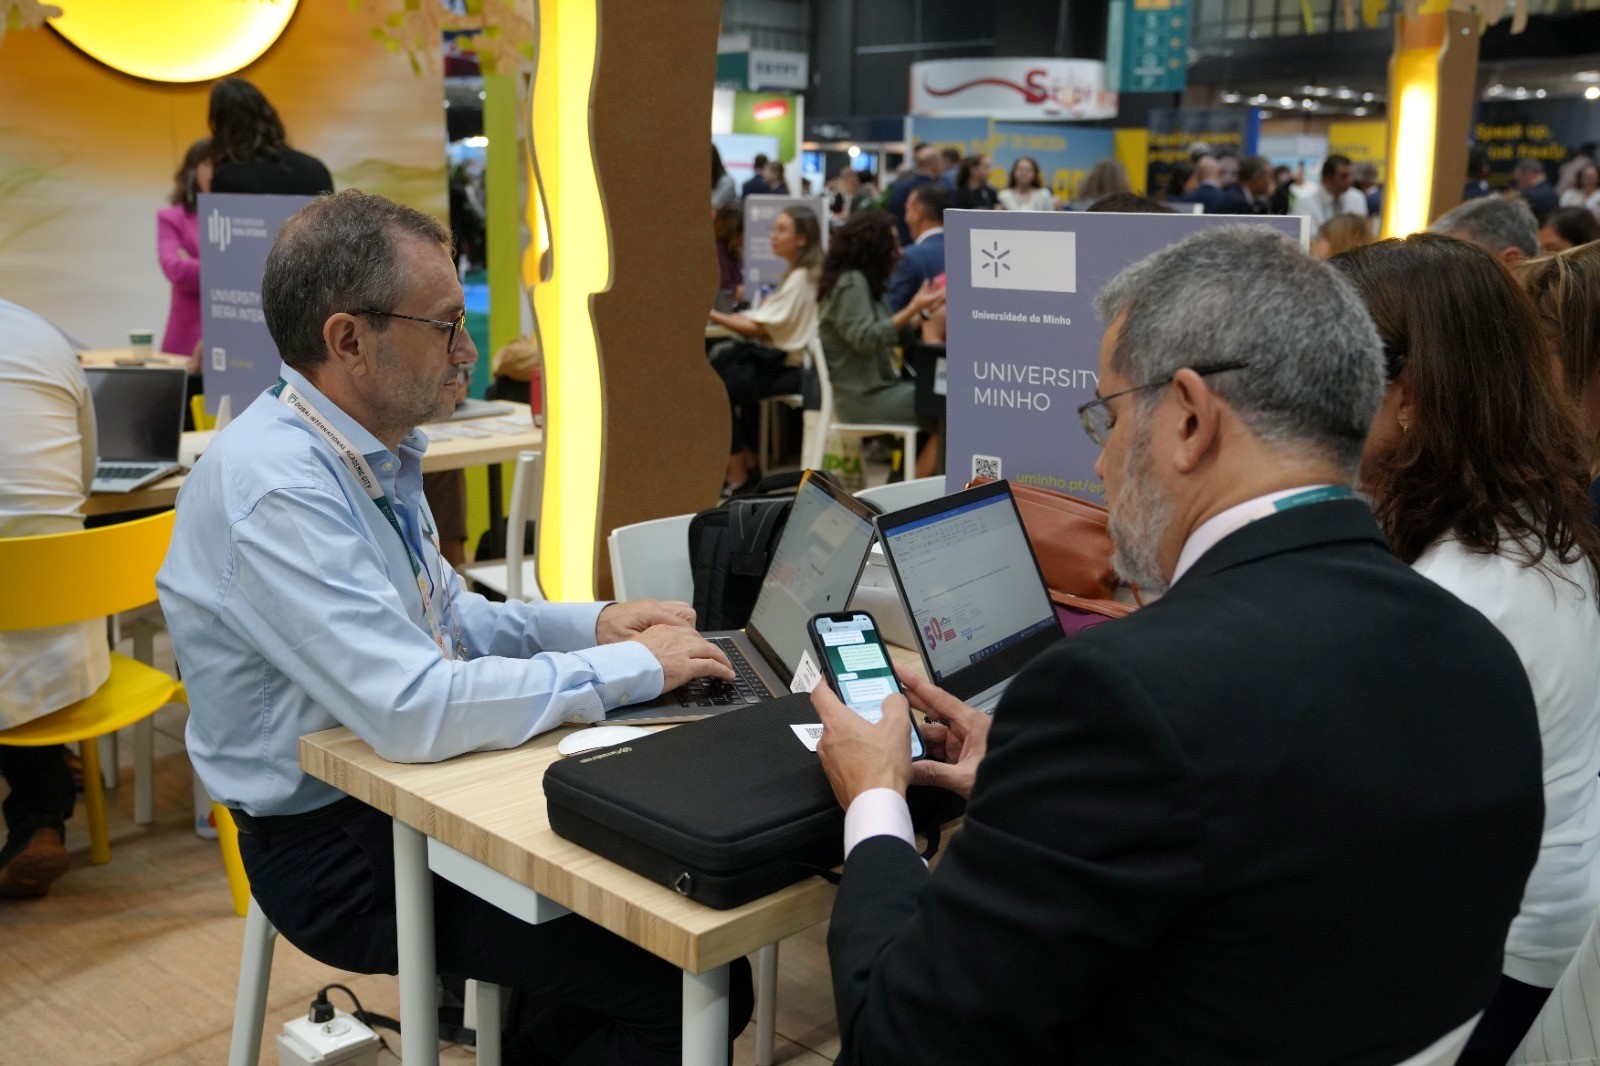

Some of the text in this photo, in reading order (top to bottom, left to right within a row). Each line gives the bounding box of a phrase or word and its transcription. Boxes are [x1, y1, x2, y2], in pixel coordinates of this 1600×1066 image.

[1475, 123, 1522, 141] Speak
[239, 307, 265, 323] INTER
[972, 310, 1071, 326] Universidade do Minho
[974, 386, 1051, 412] MINHO
[294, 401, 373, 489] DUBAI INTERNATIONAL ACADEMIC CITY
